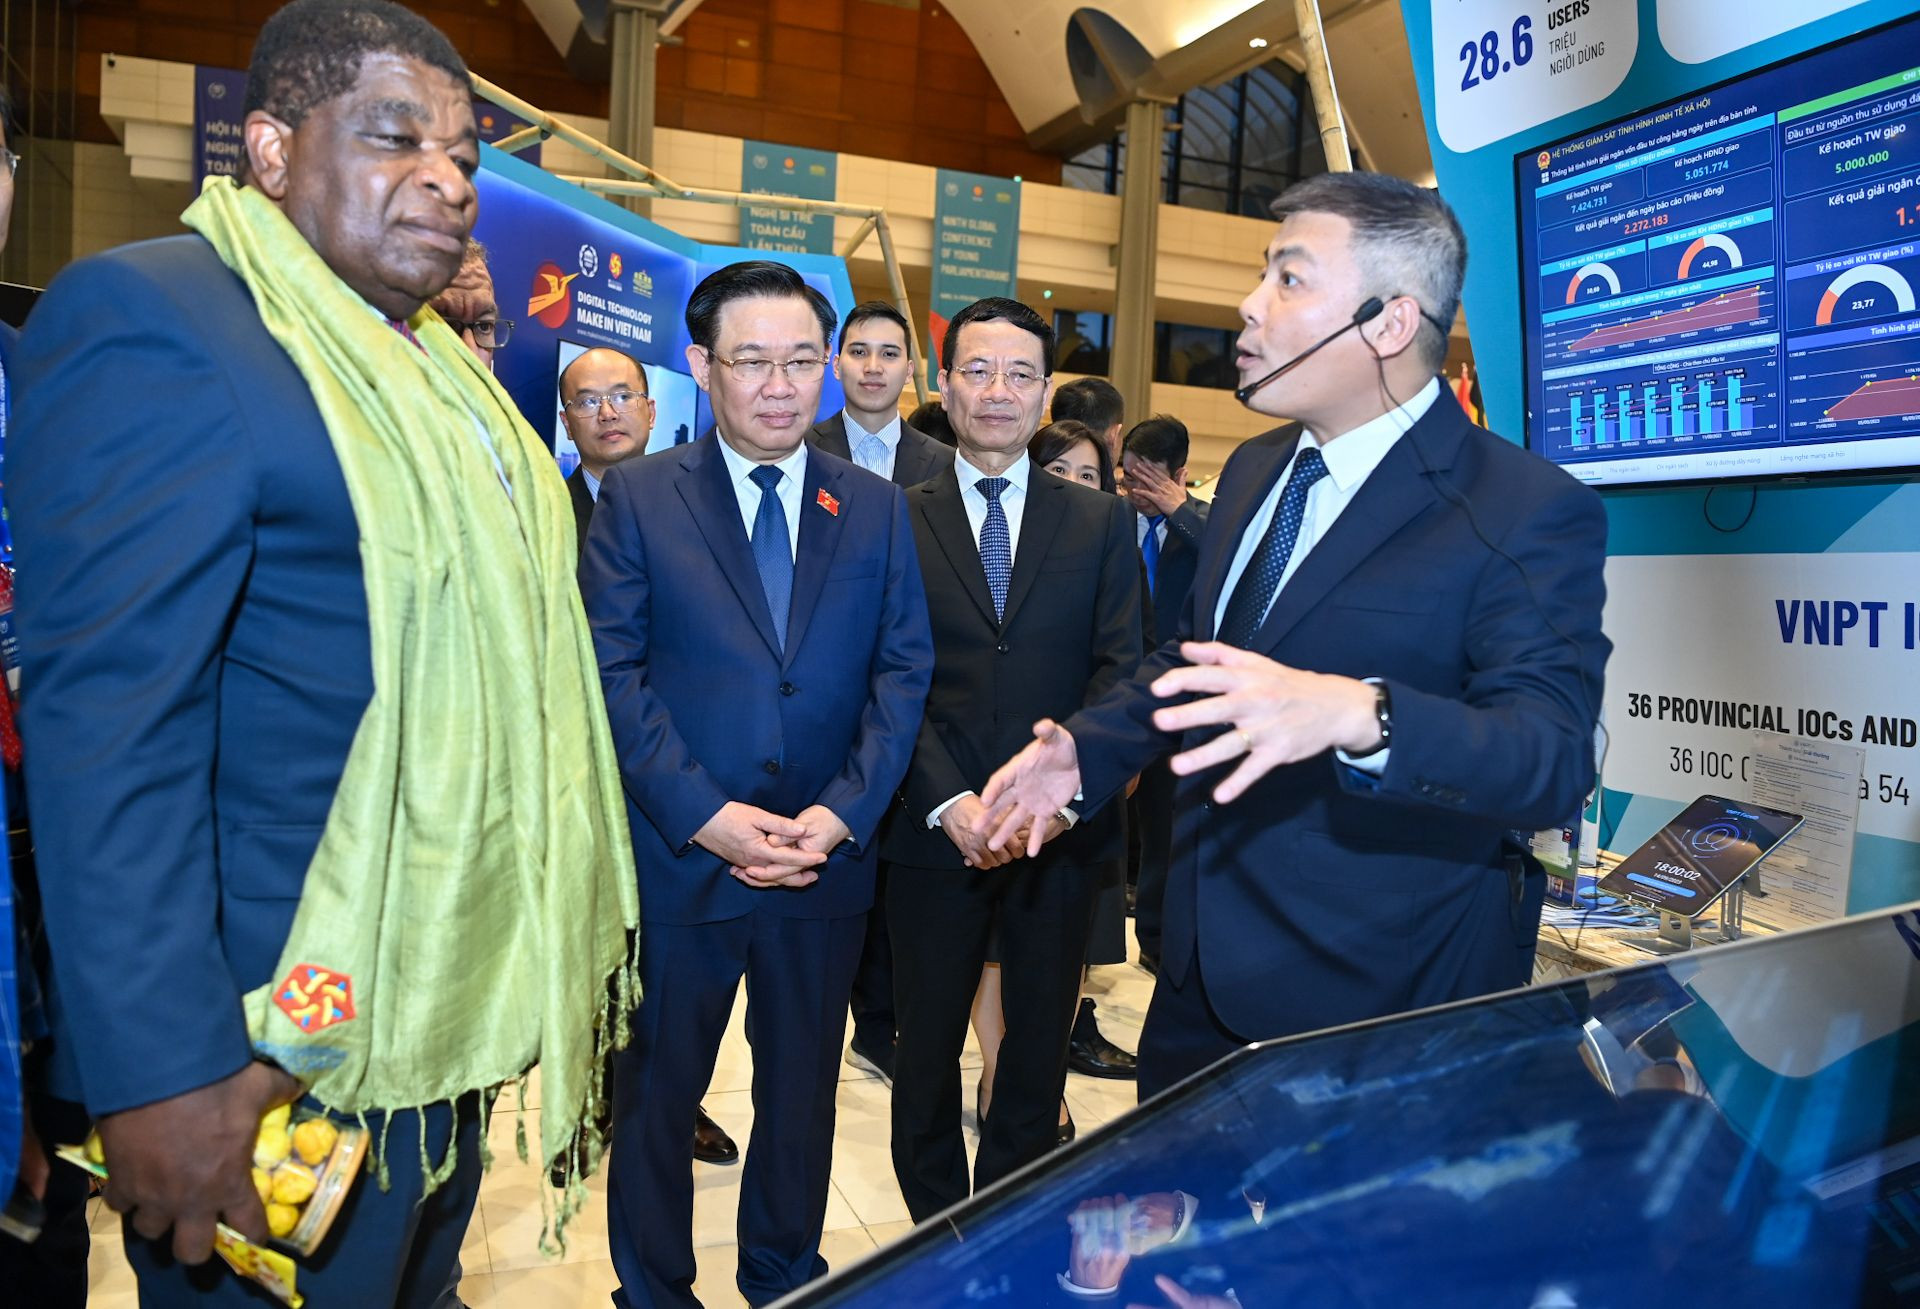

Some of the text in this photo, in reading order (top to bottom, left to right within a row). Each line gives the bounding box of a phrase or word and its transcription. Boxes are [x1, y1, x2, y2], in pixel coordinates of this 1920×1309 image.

[1548, 0, 1590, 30] USERS
[1460, 15, 1533, 92] 28.6
[1548, 31, 1576, 55] TRIỆU
[1578, 41, 1605, 65] DÙNG
[1562, 140, 1585, 156] THỐNG
[1586, 136, 1604, 148] GIÁM
[1604, 130, 1616, 142] SÁT
[1618, 124, 1634, 136] TÌNH
[1635, 118, 1654, 130] HÌNH
[1656, 111, 1674, 124] KINH
[1674, 104, 1684, 118] TẾ
[1684, 102, 1695, 114] XÃ
[1696, 97, 1711, 110] HỘI
[1788, 128, 1804, 140] Đầu
[1806, 125, 1816, 136] tư
[1816, 122, 1826, 132] từ
[1827, 114, 1854, 132] nguồn
[1856, 110, 1870, 120] thu
[1872, 104, 1882, 113] sử
[1884, 98, 1908, 112] dụng
[1586, 157, 1598, 166] hình
[1610, 149, 1624, 160] ngân
[1636, 141, 1648, 150] đầu
[1656, 134, 1672, 144] công
[1688, 124, 1704, 134] ngày
[1704, 118, 1718, 128] trên
[1718, 114, 1730, 124] địa
[1819, 124, 1906, 155] Kế hoạch TW giao
[1674, 143, 1740, 168] Kế hoạch HĐND giao
[1835, 150, 1890, 174] 5.000.000
[1685, 160, 1729, 180] 5.051.774
[1566, 182, 1613, 201] Kế hoạch TW giao
[1571, 195, 1608, 214] 7.424.731
[1828, 194, 1844, 206] Kết
[1846, 188, 1865, 204] quả
[1867, 183, 1885, 200] giải
[1888, 177, 1913, 194] ngân
[1575, 222, 1586, 232] Kết
[1610, 212, 1626, 224] ngân
[1626, 208, 1639, 219] đến
[1640, 204, 1656, 216] ngày
[1656, 199, 1670, 210] báo
[1670, 196, 1682, 206] cáo
[1684, 190, 1702, 204] (Triệu
[1702, 184, 1725, 198] đồng)
[1624, 214, 1668, 235] 2.272.183
[942, 231, 993, 249] CONFERENCE
[953, 249, 980, 262] YOUNG
[1826, 260, 1832, 270] lệ
[1843, 256, 1855, 266] với
[1856, 254, 1867, 263] KH
[1868, 251, 1881, 260] TW
[1882, 248, 1900, 260] giao
[1901, 246, 1914, 256] (%)
[578, 290, 606, 310] DIGITAL
[608, 300, 652, 325] TECHNOLOGY
[1852, 298, 1875, 310] 23,77
[577, 308, 652, 344] MAKE IN VIET NAM
[1776, 600, 1920, 649] VNPT I
[1628, 692, 1917, 748] 36 PROVINCIAL IOCs AND
[1670, 747, 1693, 774] 36
[1700, 750, 1732, 780] IOC
[1879, 774, 1910, 806] 54
[1654, 861, 1702, 881] 18:00:02
